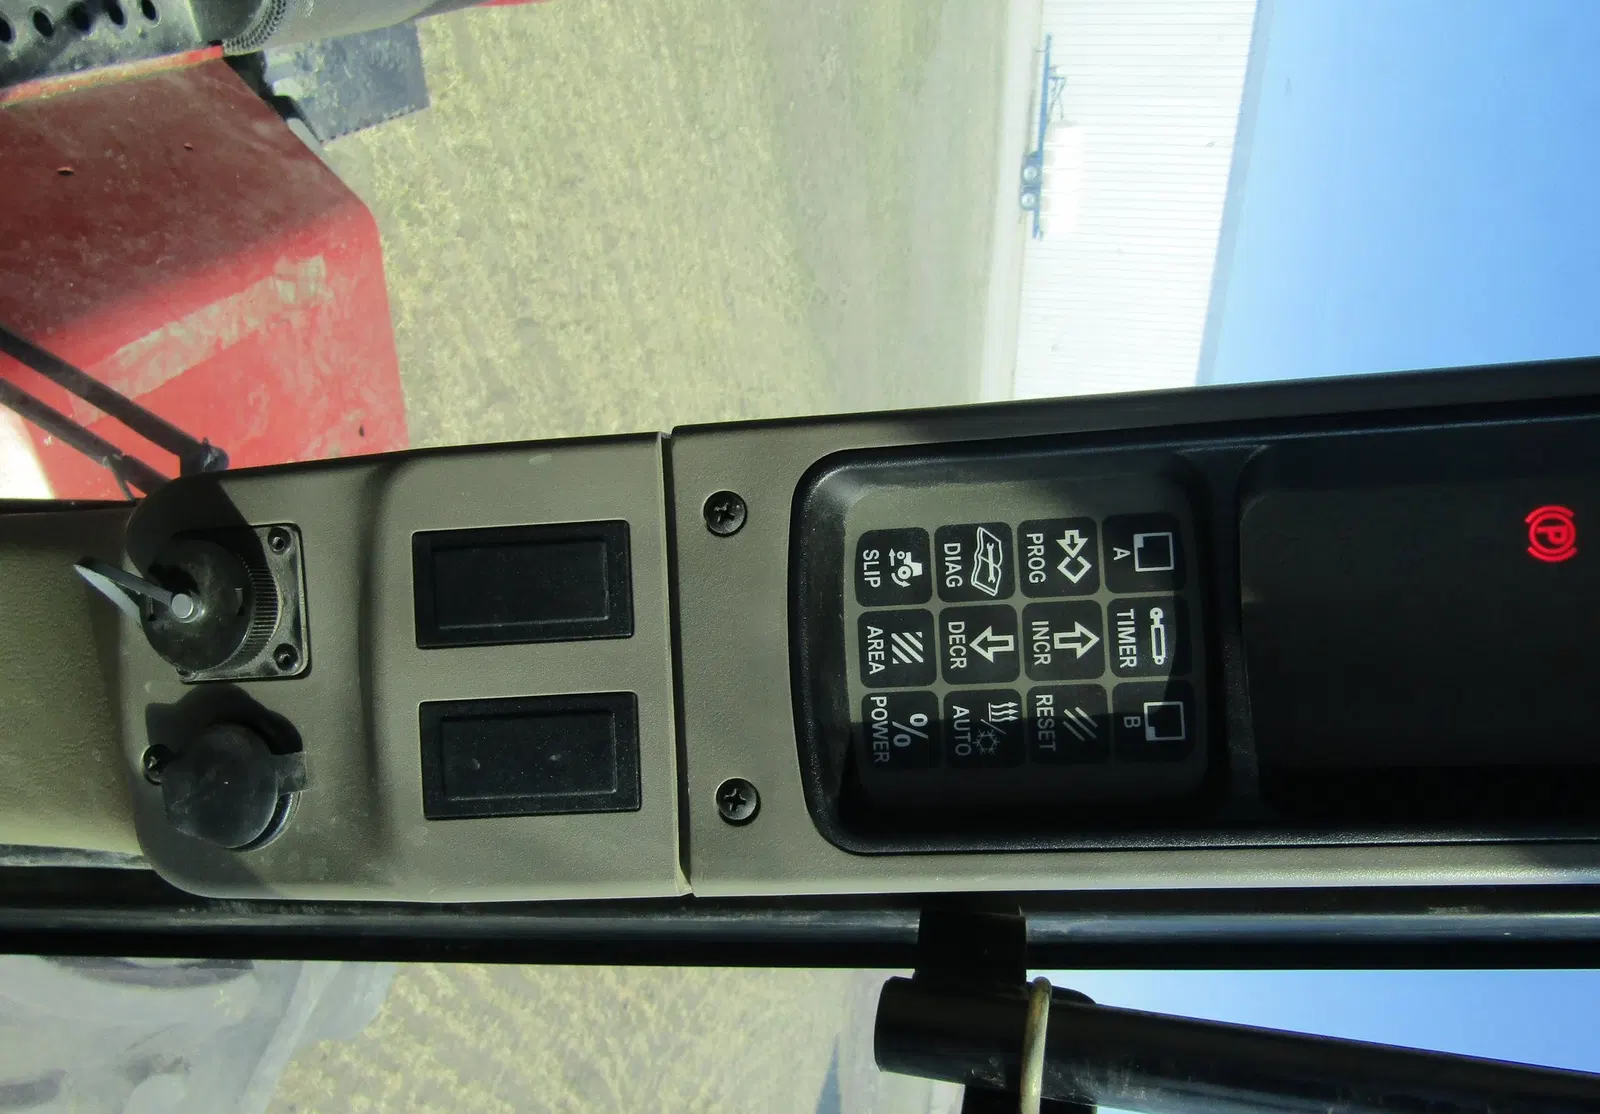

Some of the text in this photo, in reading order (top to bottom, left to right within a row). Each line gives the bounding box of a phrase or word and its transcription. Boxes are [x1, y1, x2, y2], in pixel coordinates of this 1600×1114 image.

[862, 549, 881, 588] SLIP
[943, 542, 963, 588] DIAG
[1026, 532, 1047, 584] PROG
[1112, 547, 1131, 561] A
[866, 625, 886, 675] AREA
[947, 621, 967, 670] DECR
[1031, 620, 1051, 666] INCR
[1116, 608, 1138, 669] TIMER
[870, 696, 890, 763] POWER
[952, 705, 972, 757] AUTO
[1035, 694, 1056, 752] RESET
[1123, 715, 1141, 729] B
